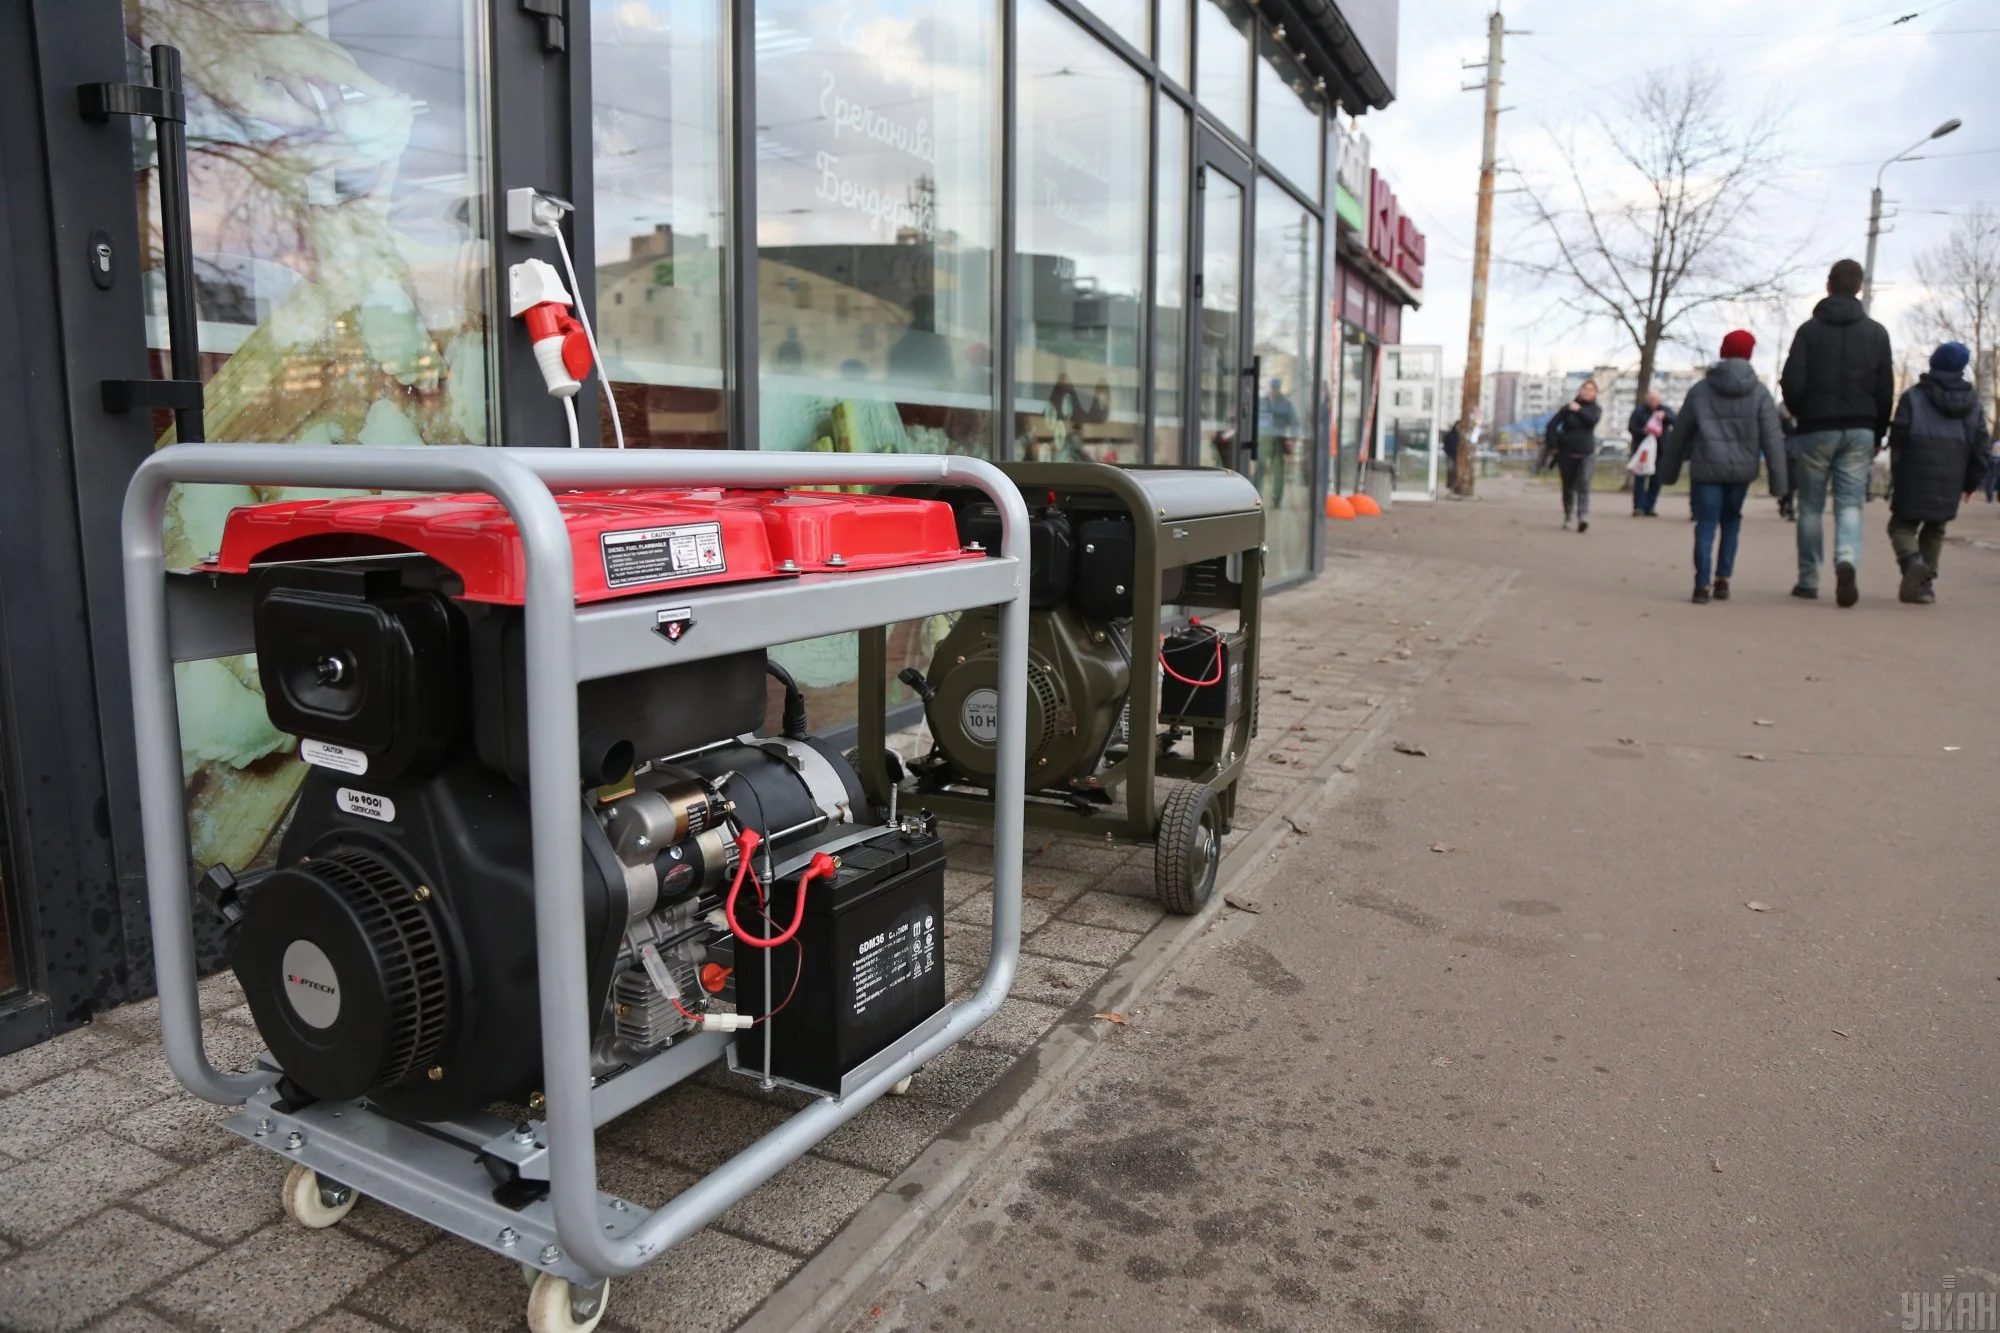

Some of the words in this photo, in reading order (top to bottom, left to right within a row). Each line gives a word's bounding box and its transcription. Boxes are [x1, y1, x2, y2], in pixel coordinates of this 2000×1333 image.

[651, 531, 676, 539] CAUTION
[608, 546, 625, 554] DIESEL
[638, 542, 667, 550] FLAMMABLE
[969, 715, 983, 727] 10
[986, 715, 996, 727] H
[322, 744, 344, 755] CAUTION
[361, 795, 382, 808] 9001
[350, 804, 381, 817] CERTIFICATION
[859, 933, 885, 955] 6DM36
